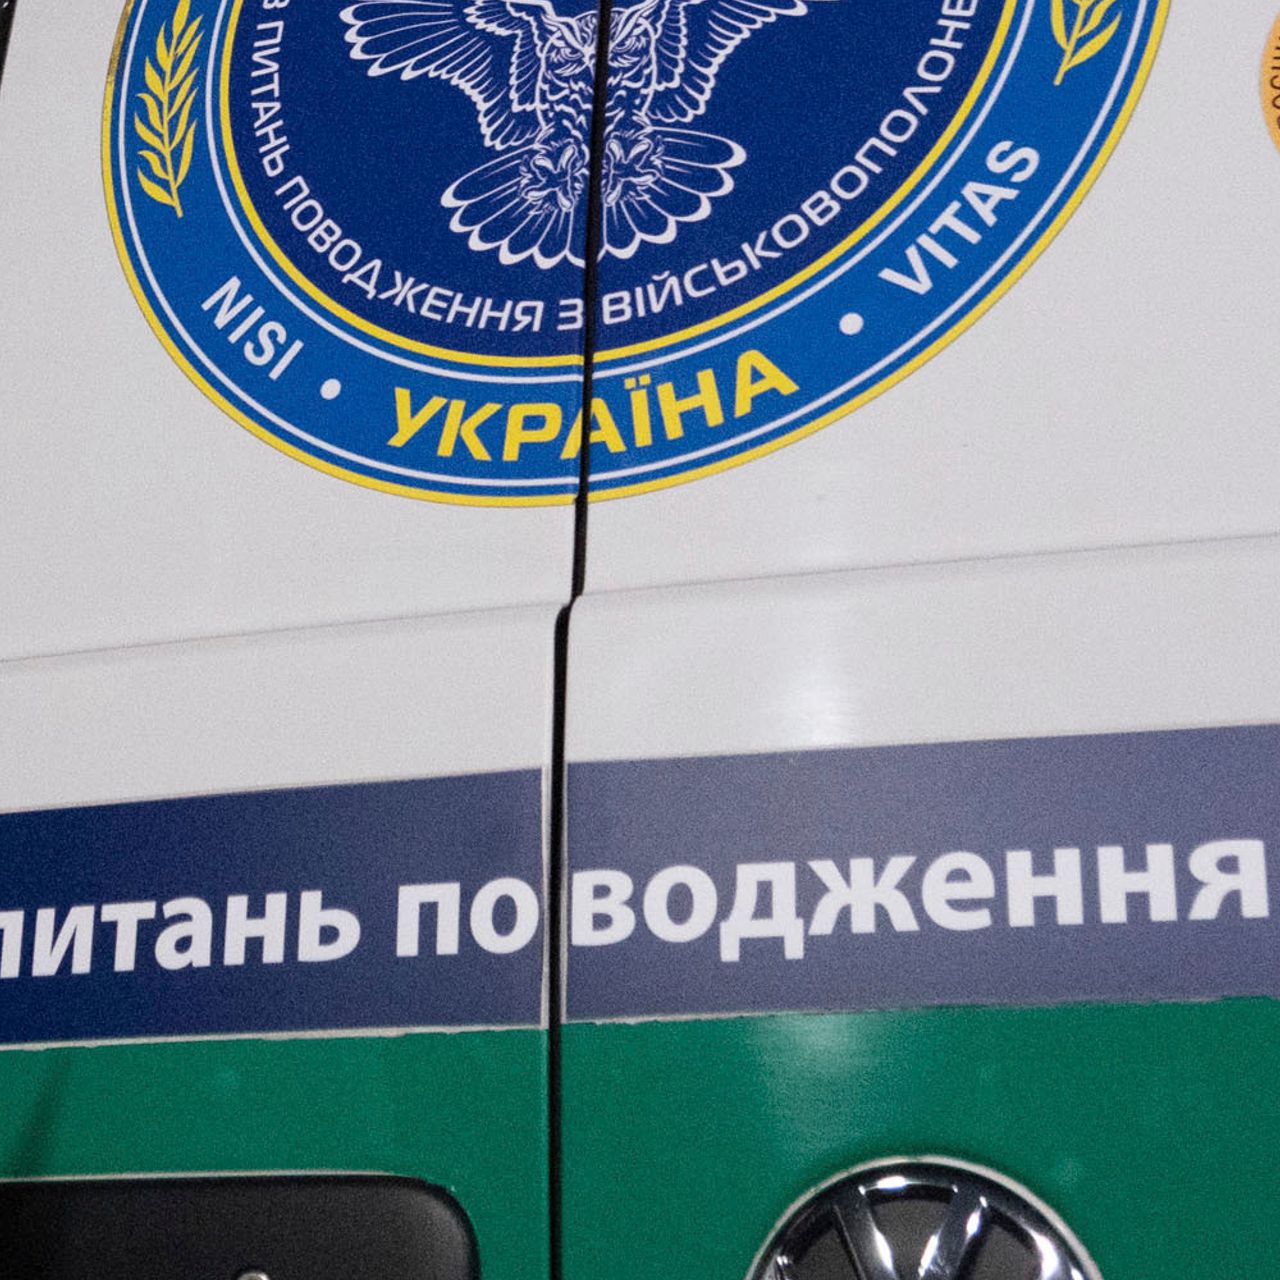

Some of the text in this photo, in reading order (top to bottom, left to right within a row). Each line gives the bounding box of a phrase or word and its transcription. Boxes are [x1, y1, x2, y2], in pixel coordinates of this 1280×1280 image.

[250, 20, 286, 176] ПИТАНЬ
[275, 174, 544, 333] ПОВОДЖЕННЯ
[556, 298, 585, 331] З
[878, 139, 1040, 296] VITAS
[200, 275, 304, 381] NISI
[386, 349, 800, 462] УКРАЇНА
